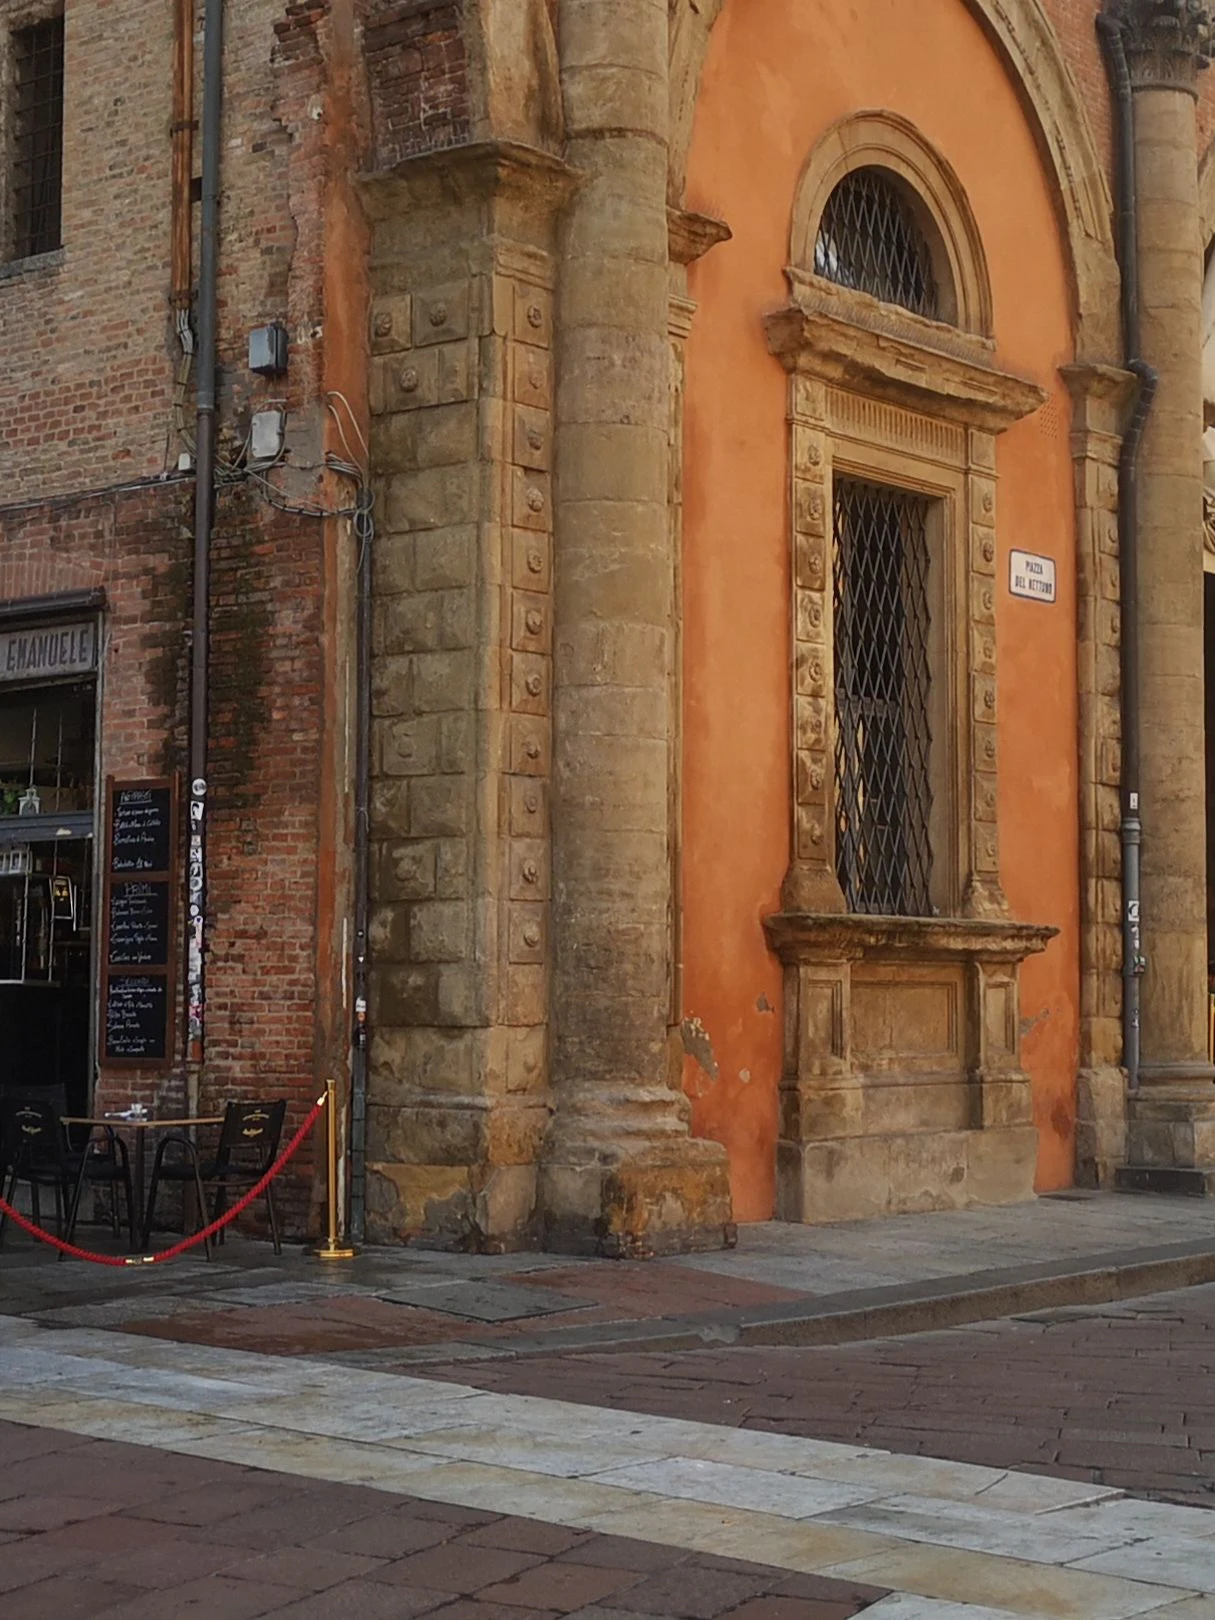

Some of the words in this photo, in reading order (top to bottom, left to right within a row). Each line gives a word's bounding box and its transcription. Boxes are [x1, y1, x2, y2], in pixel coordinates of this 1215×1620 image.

[1025, 561, 1043, 575] PIAZZA
[1015, 575, 1025, 588] DEL
[1029, 579, 1052, 594] NETTUNO
[6, 629, 89, 671] EMANUELE
